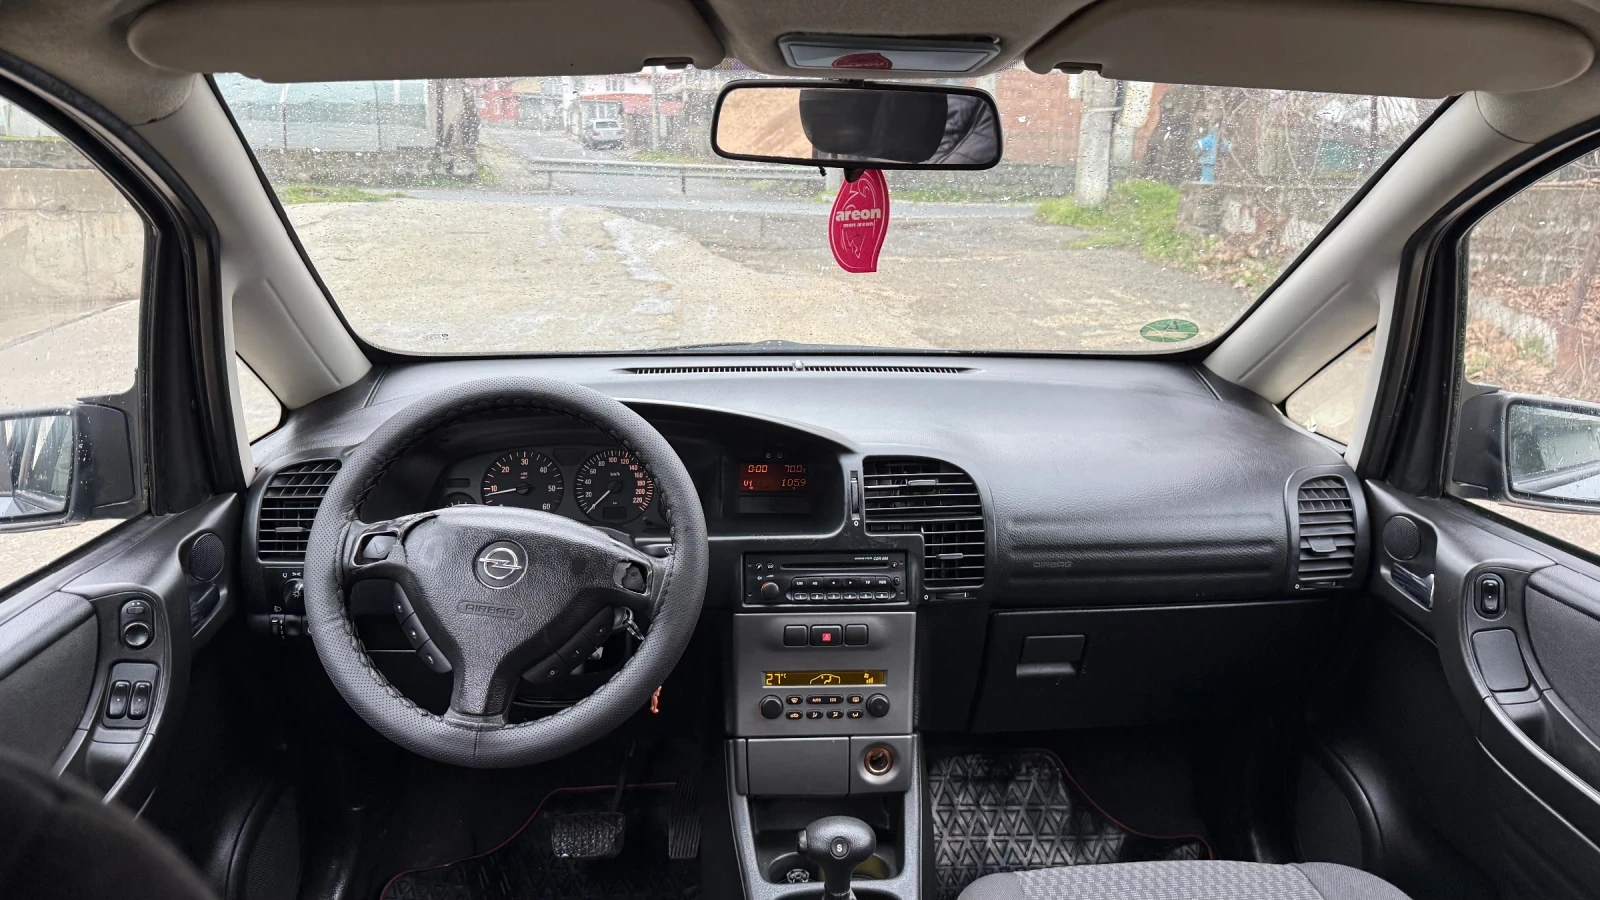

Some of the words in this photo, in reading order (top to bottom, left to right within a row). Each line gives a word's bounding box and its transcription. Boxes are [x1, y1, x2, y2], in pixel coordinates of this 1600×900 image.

[835, 208, 881, 221] areon
[465, 604, 517, 616] AIRBAG
[836, 844, 843, 852] S
